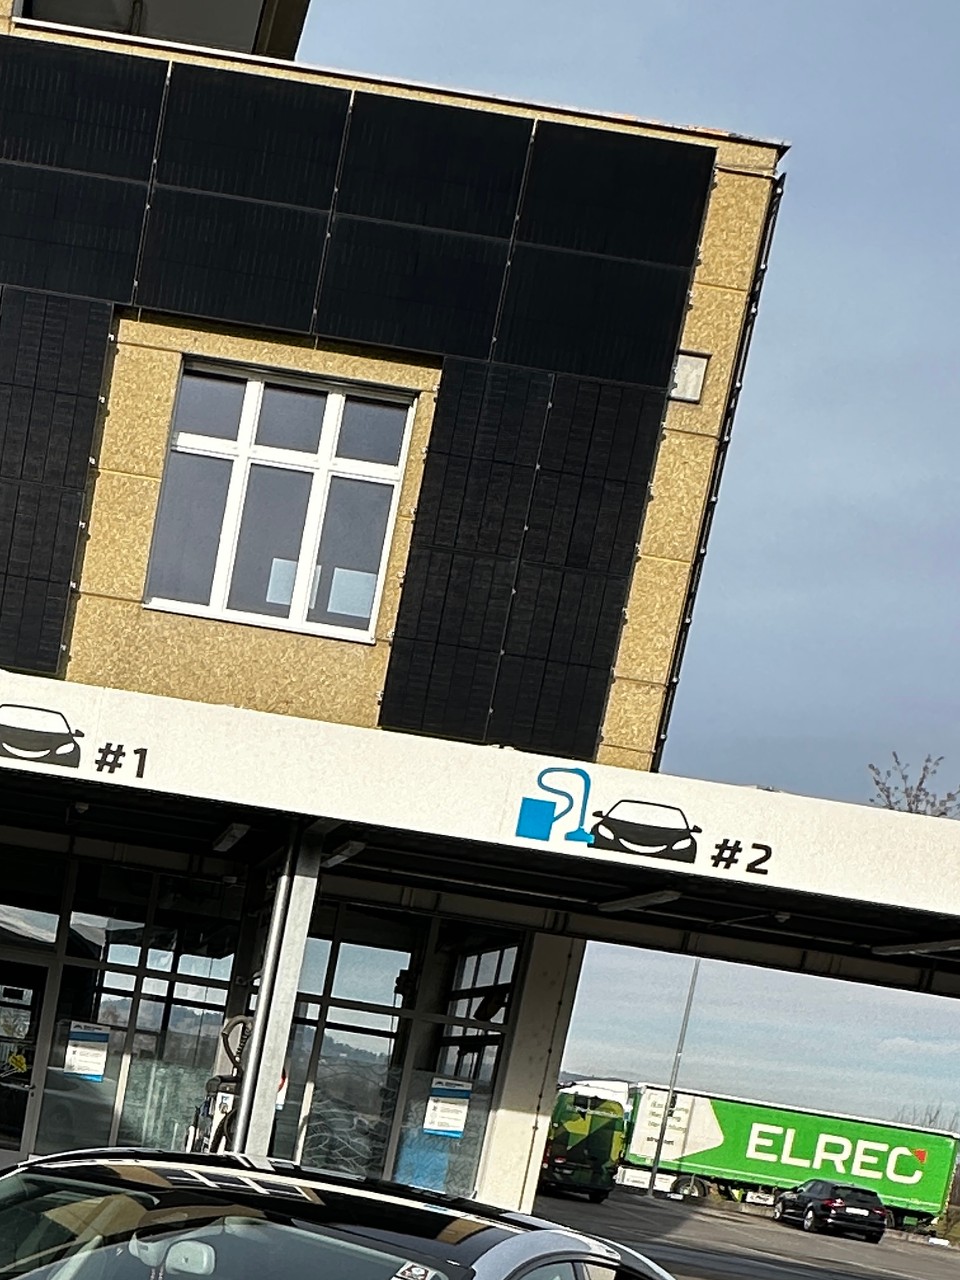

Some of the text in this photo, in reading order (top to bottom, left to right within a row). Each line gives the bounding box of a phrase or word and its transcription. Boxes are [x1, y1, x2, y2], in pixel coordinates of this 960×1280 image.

[95, 742, 148, 778] #1
[711, 838, 772, 875] #2
[745, 1122, 924, 1185] ELREC
